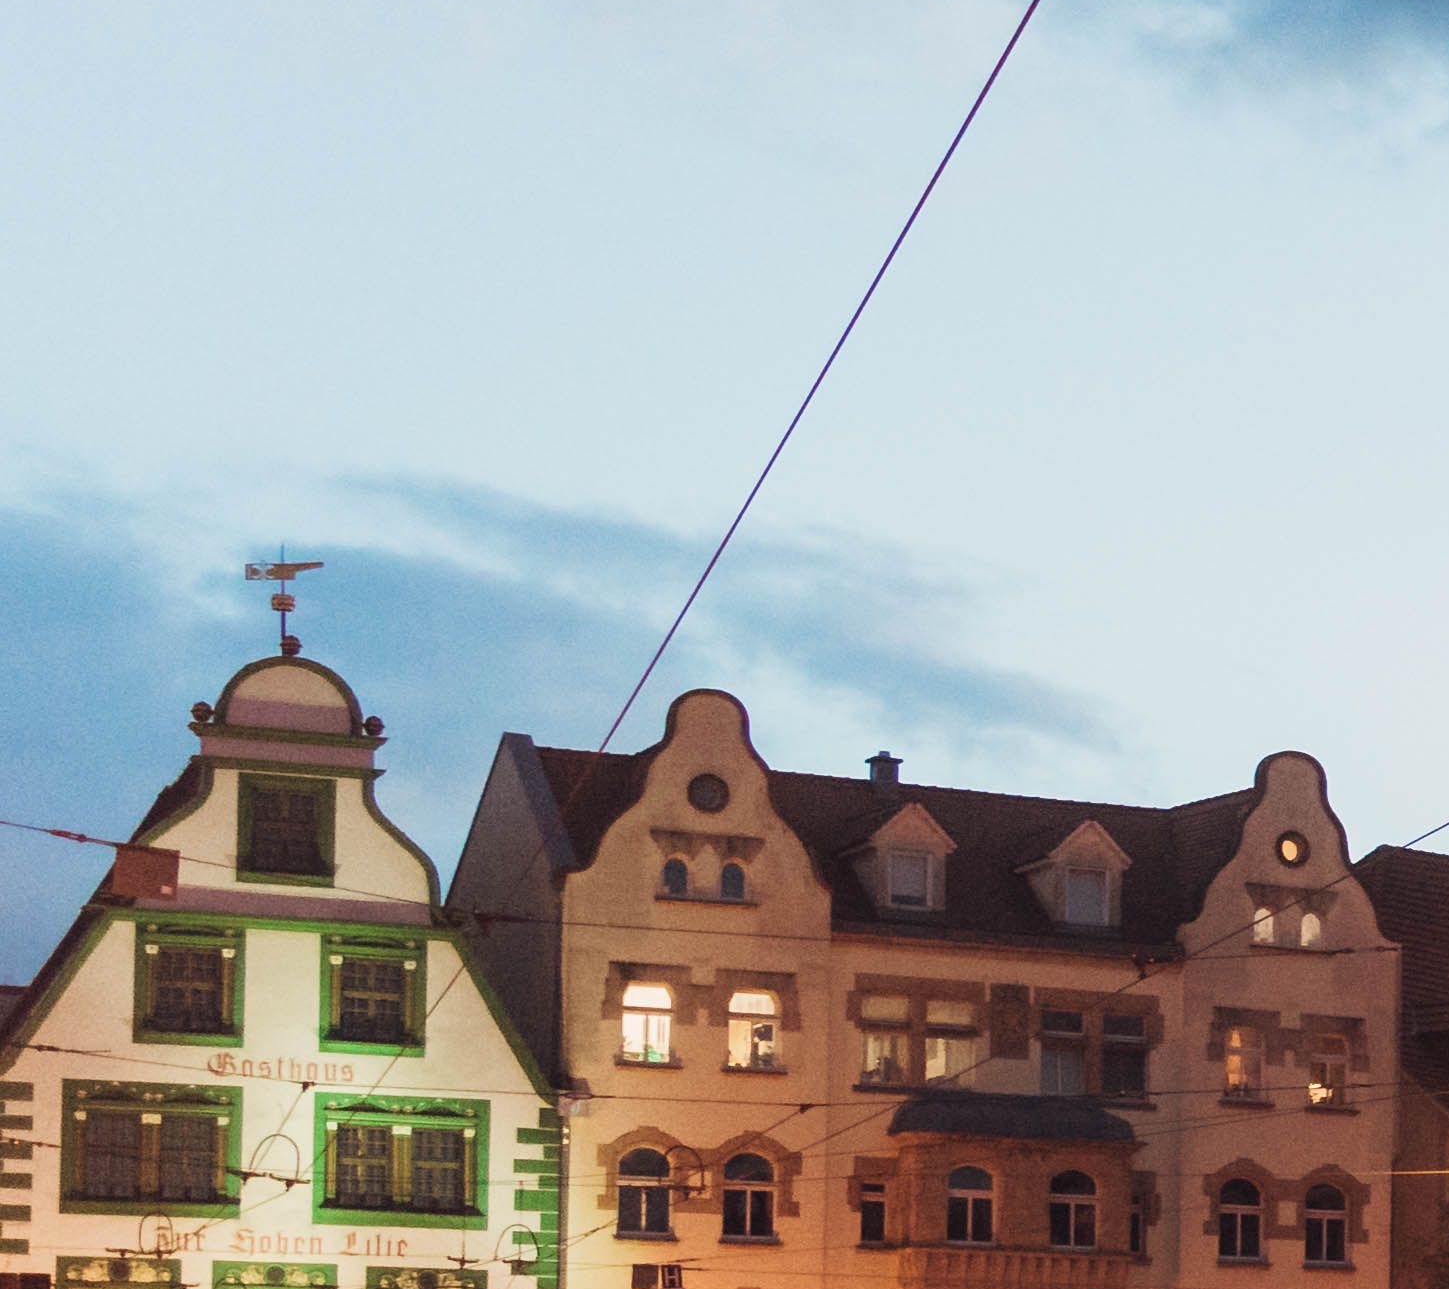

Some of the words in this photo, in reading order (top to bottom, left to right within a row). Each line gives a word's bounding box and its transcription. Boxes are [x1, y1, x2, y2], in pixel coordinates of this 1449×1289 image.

[207, 1052, 354, 1082] Gasthaus
[229, 1228, 323, 1257] Hohen
[339, 1231, 409, 1257] Lilie
